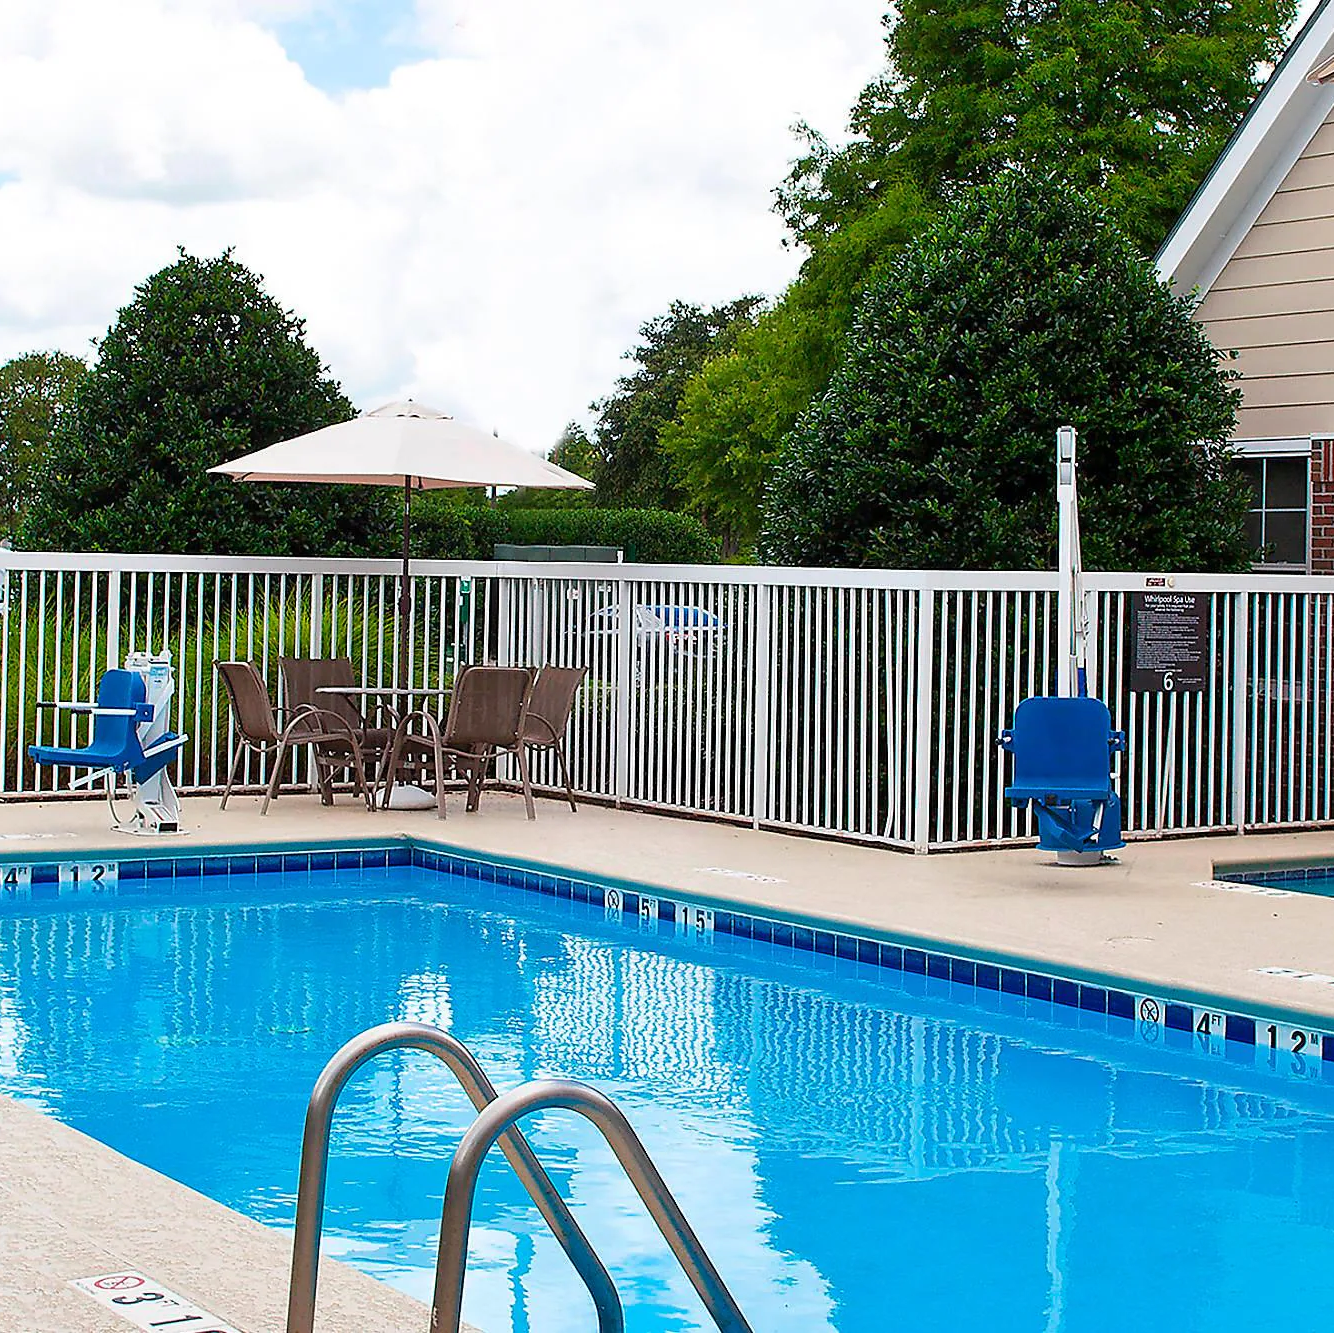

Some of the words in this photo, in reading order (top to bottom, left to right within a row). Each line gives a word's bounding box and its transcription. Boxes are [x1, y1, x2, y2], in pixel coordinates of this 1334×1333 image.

[1144, 594, 1172, 604] Whirlpool
[1173, 595, 1184, 605] Spa
[1185, 595, 1196, 604] Use
[1163, 672, 1174, 691] 6
